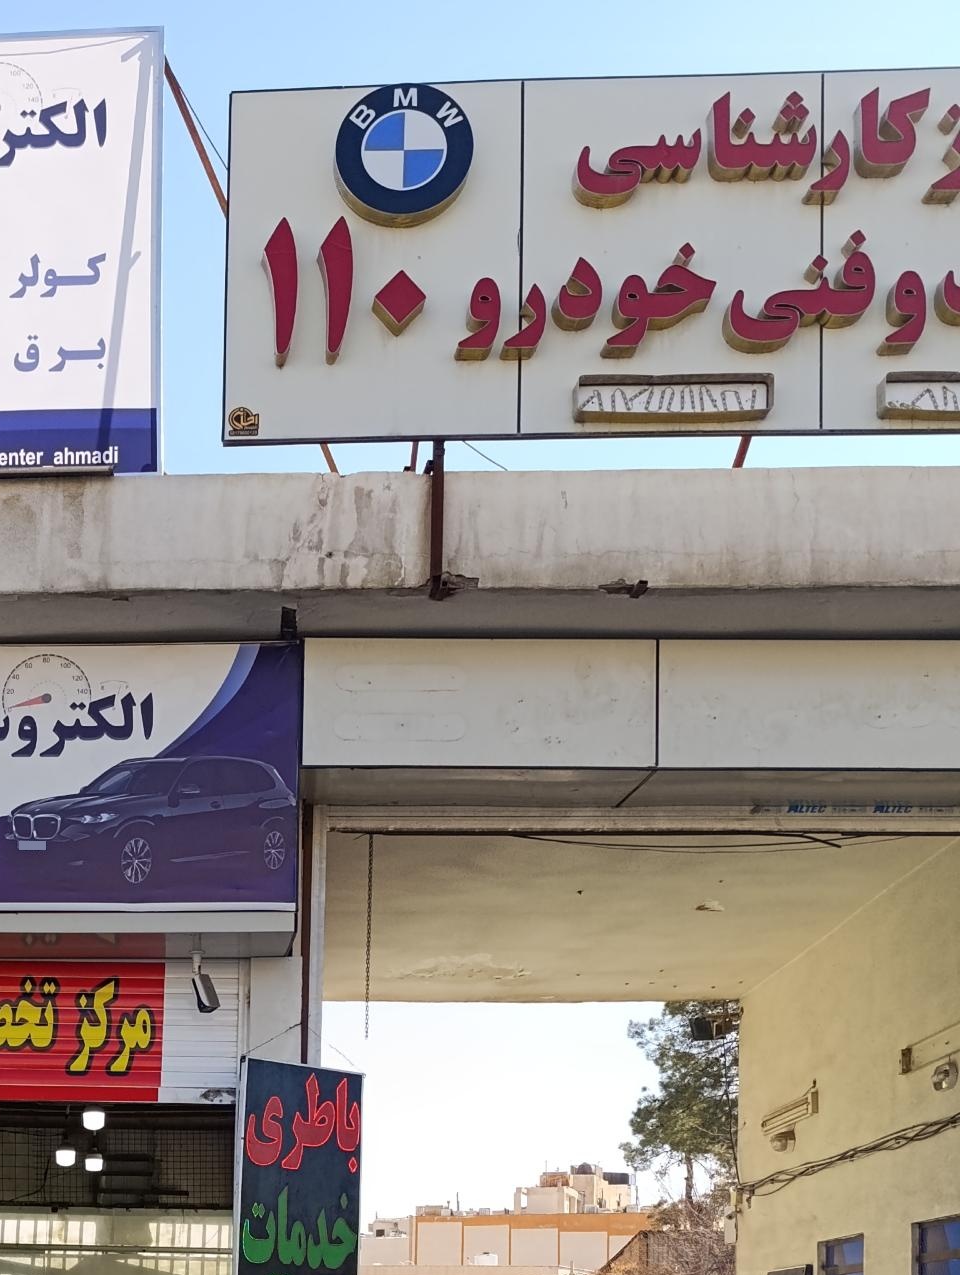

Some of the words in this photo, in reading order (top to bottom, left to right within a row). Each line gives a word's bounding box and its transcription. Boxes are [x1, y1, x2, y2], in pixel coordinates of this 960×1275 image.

[349, 87, 464, 130] BMW
[575, 87, 931, 204] کارشناسی
[9, 253, 106, 298] کولر
[455, 242, 717, 360] خودرو
[724, 229, 876, 352] فنی
[13, 334, 106, 372] برق
[69, 977, 155, 1074] مرکز
[246, 1072, 360, 1173] باطری
[242, 1185, 357, 1270] خدمات
